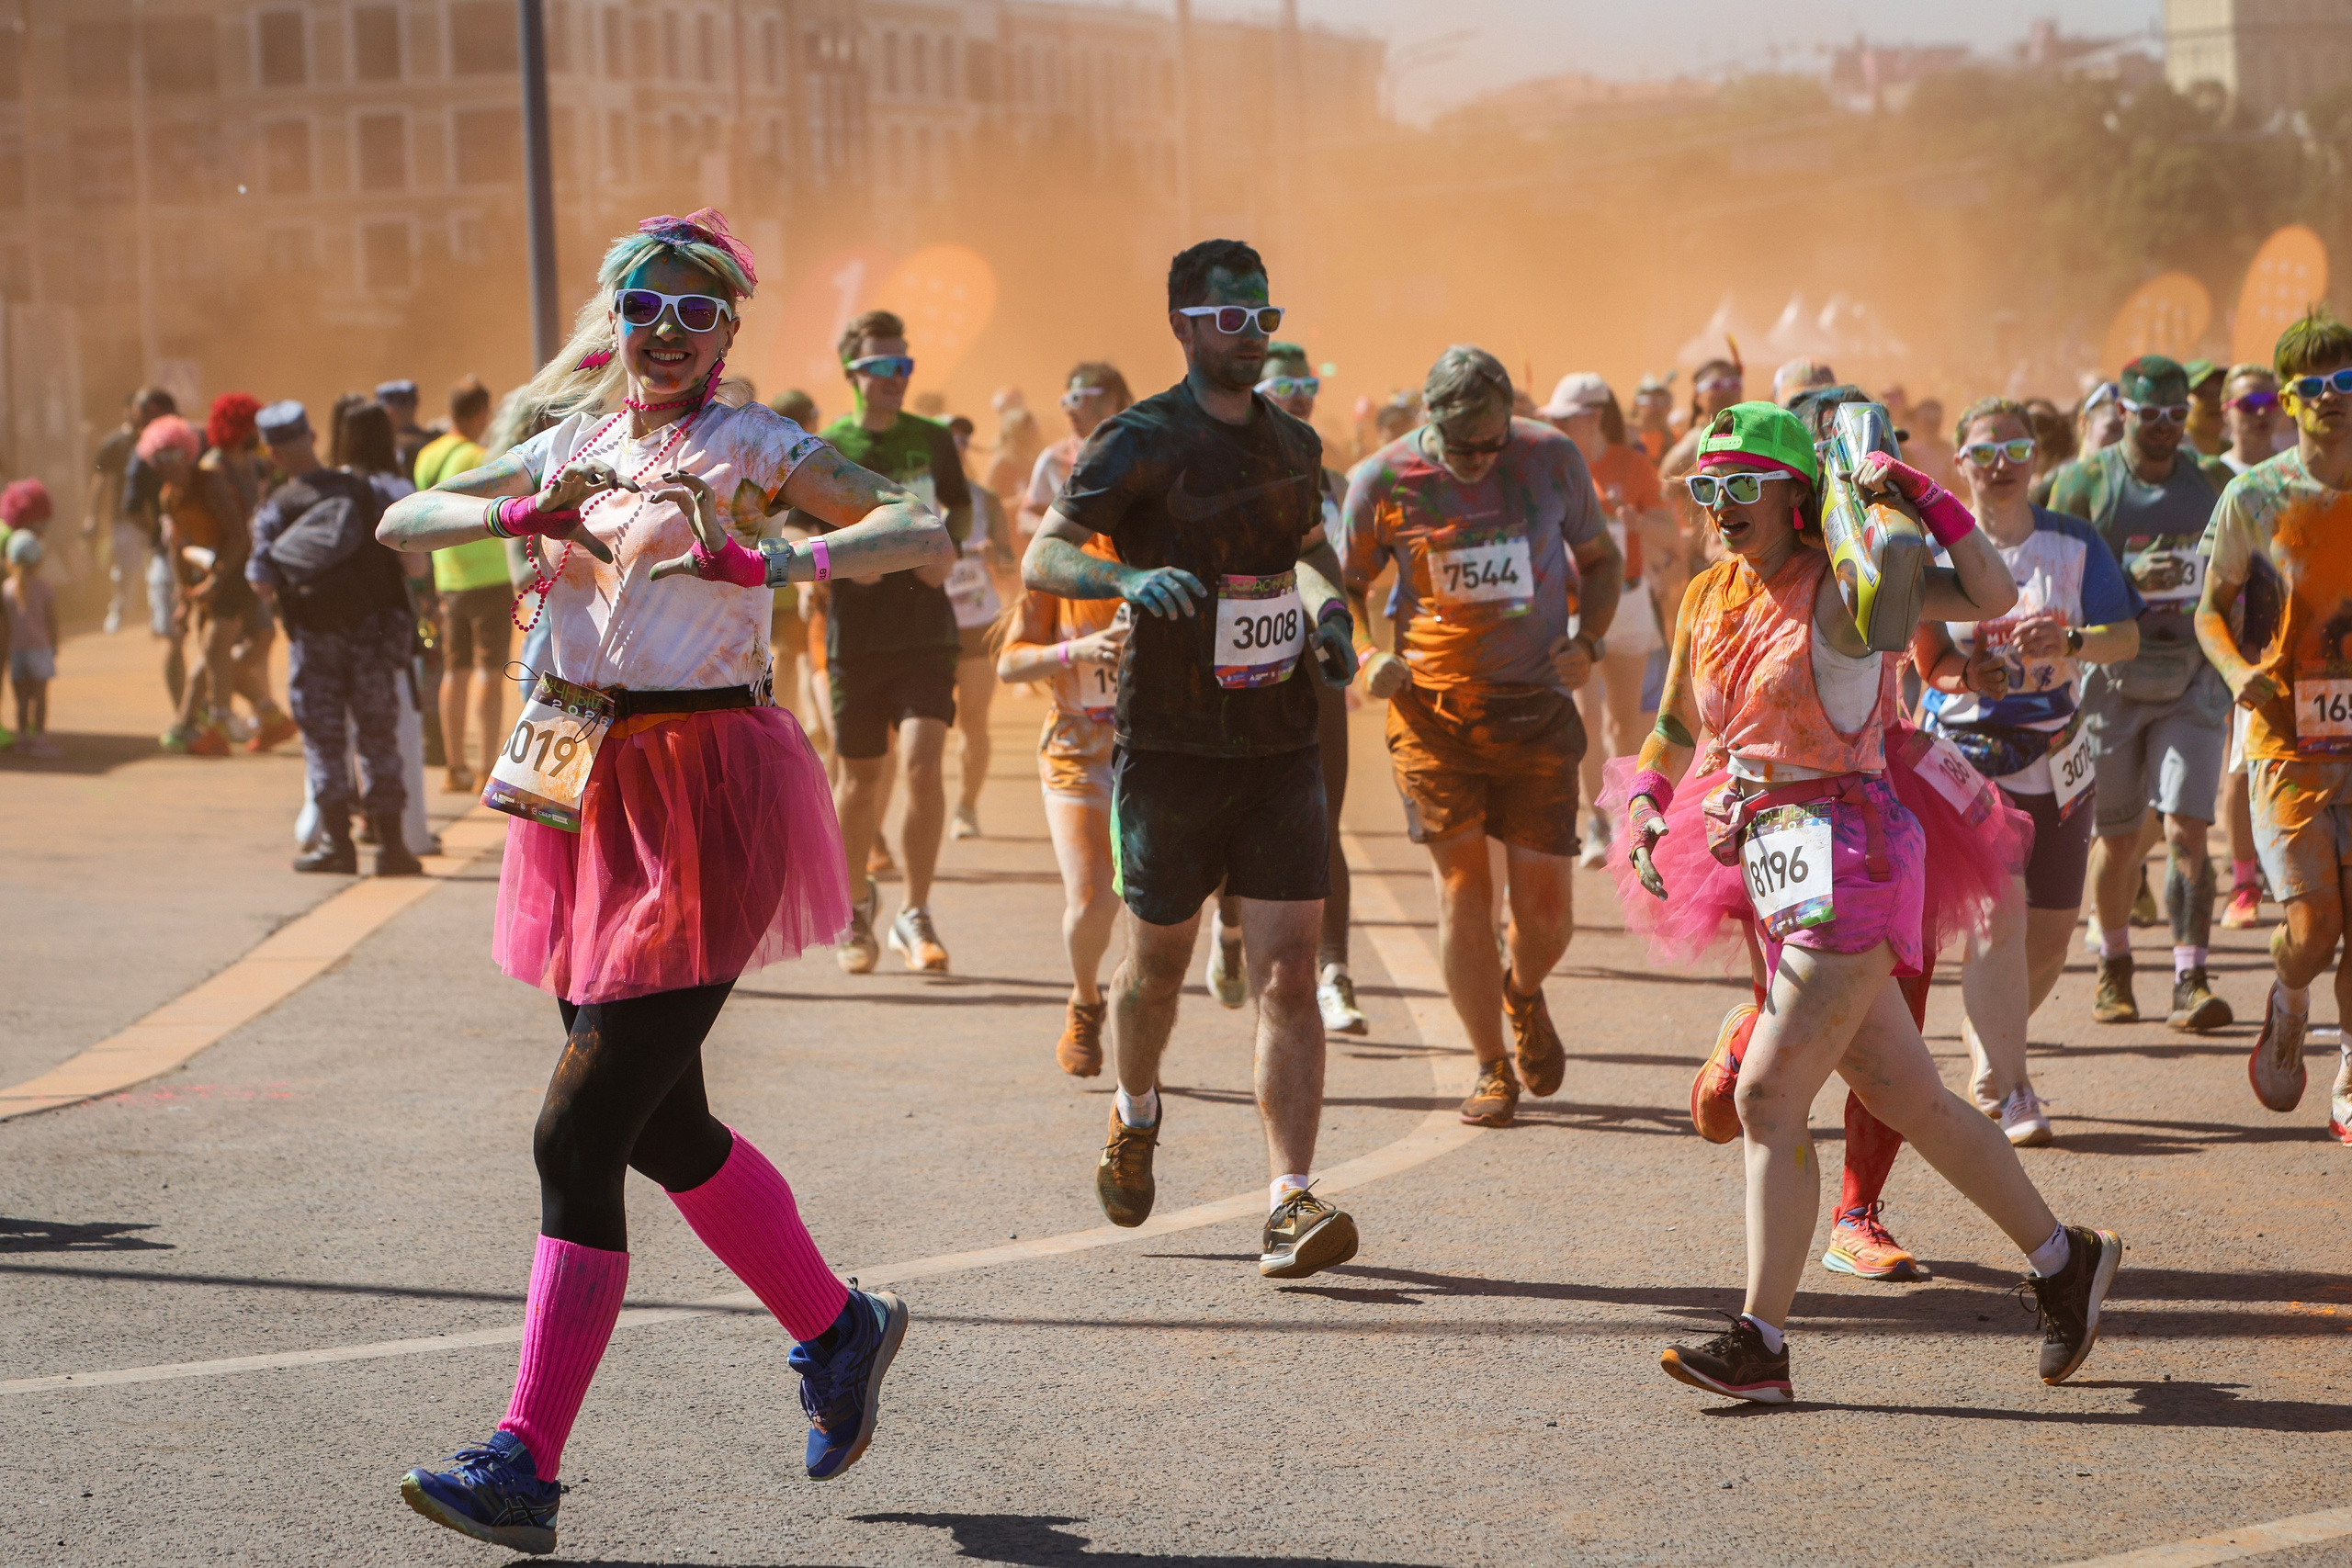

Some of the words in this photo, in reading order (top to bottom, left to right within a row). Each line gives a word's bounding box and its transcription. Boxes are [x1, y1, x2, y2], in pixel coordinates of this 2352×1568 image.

[1442, 557, 1519, 592] 7544
[1233, 608, 1297, 649] 3008
[551, 698, 610, 726] 2026
[1773, 817, 1829, 834] 2026
[1749, 845, 1809, 897] 8196
